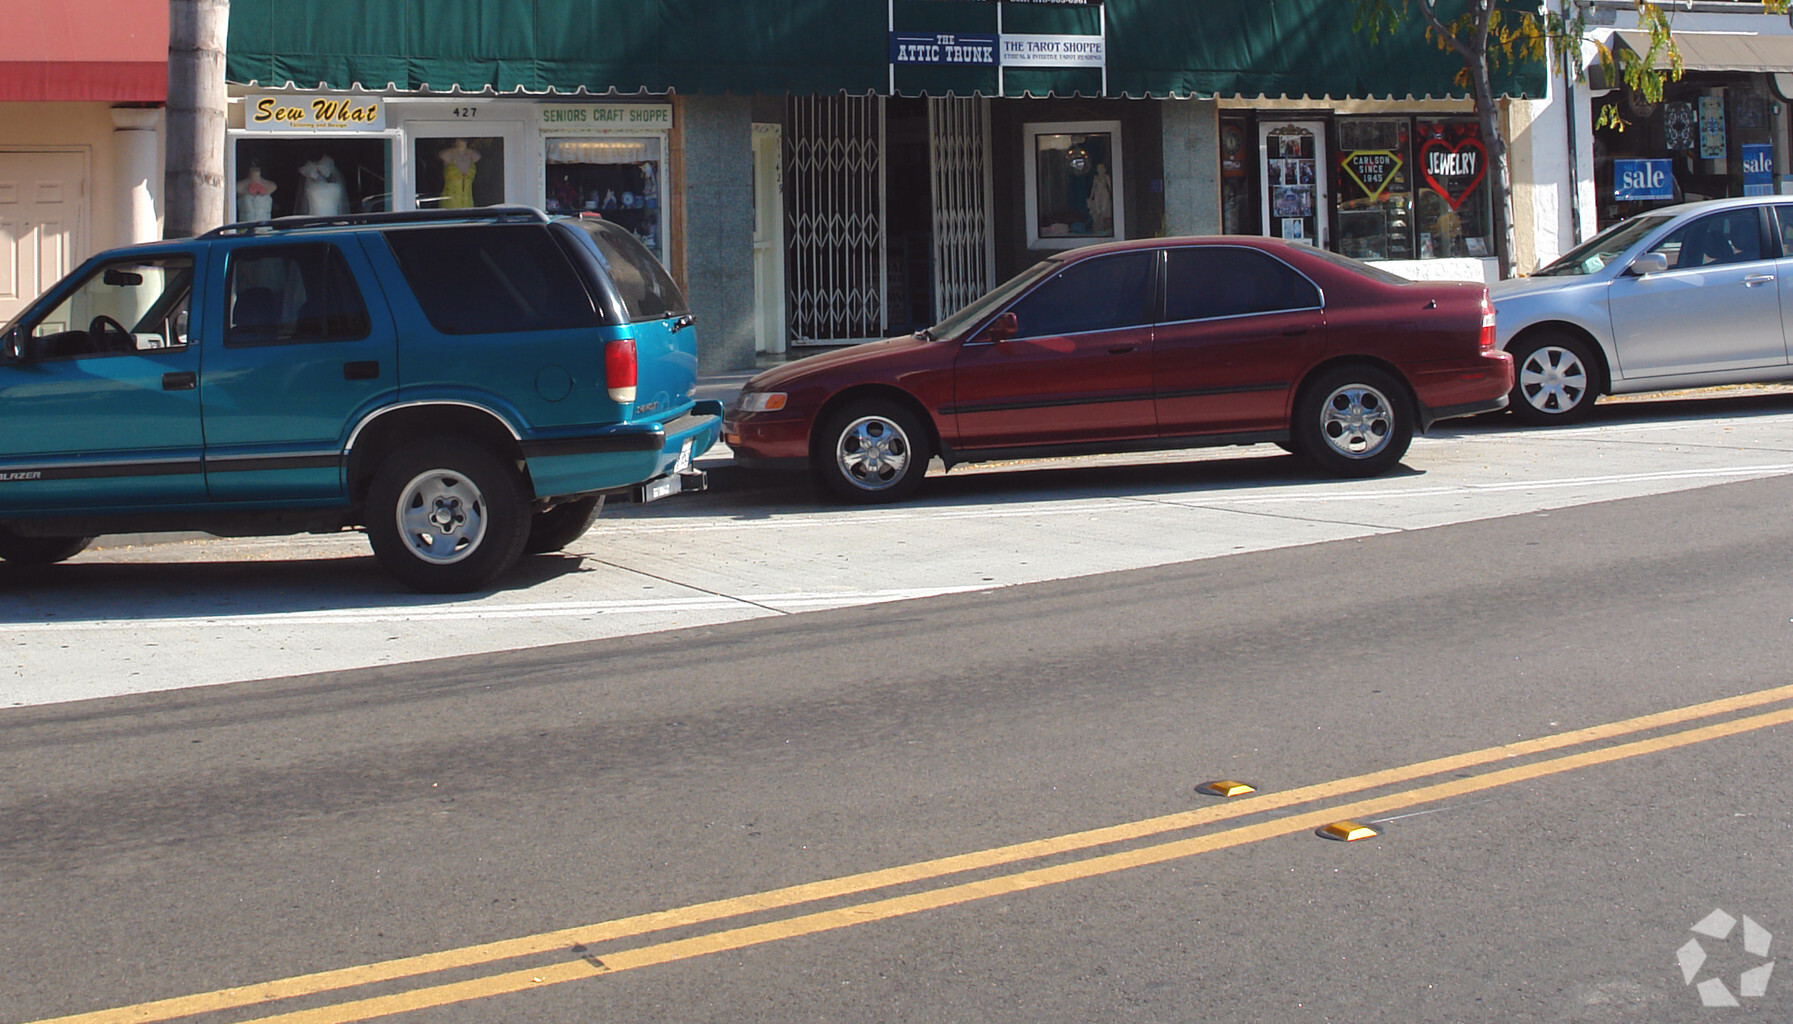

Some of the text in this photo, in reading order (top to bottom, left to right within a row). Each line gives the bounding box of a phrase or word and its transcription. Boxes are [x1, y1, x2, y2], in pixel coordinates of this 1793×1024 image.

[936, 34, 955, 45] THE
[897, 44, 993, 62] ATTIC TRUNK
[1004, 41, 1102, 53] THE TAROT SHOPPE
[253, 97, 377, 122] Sew What
[453, 107, 477, 117] 427
[543, 108, 668, 122] SENIORS CRAFT SHOPPE
[1353, 156, 1390, 165] CARLSON
[1427, 151, 1476, 176] JEWELRY
[1743, 151, 1773, 173] sale
[1358, 165, 1384, 174] SINCE
[1623, 162, 1664, 189] sale
